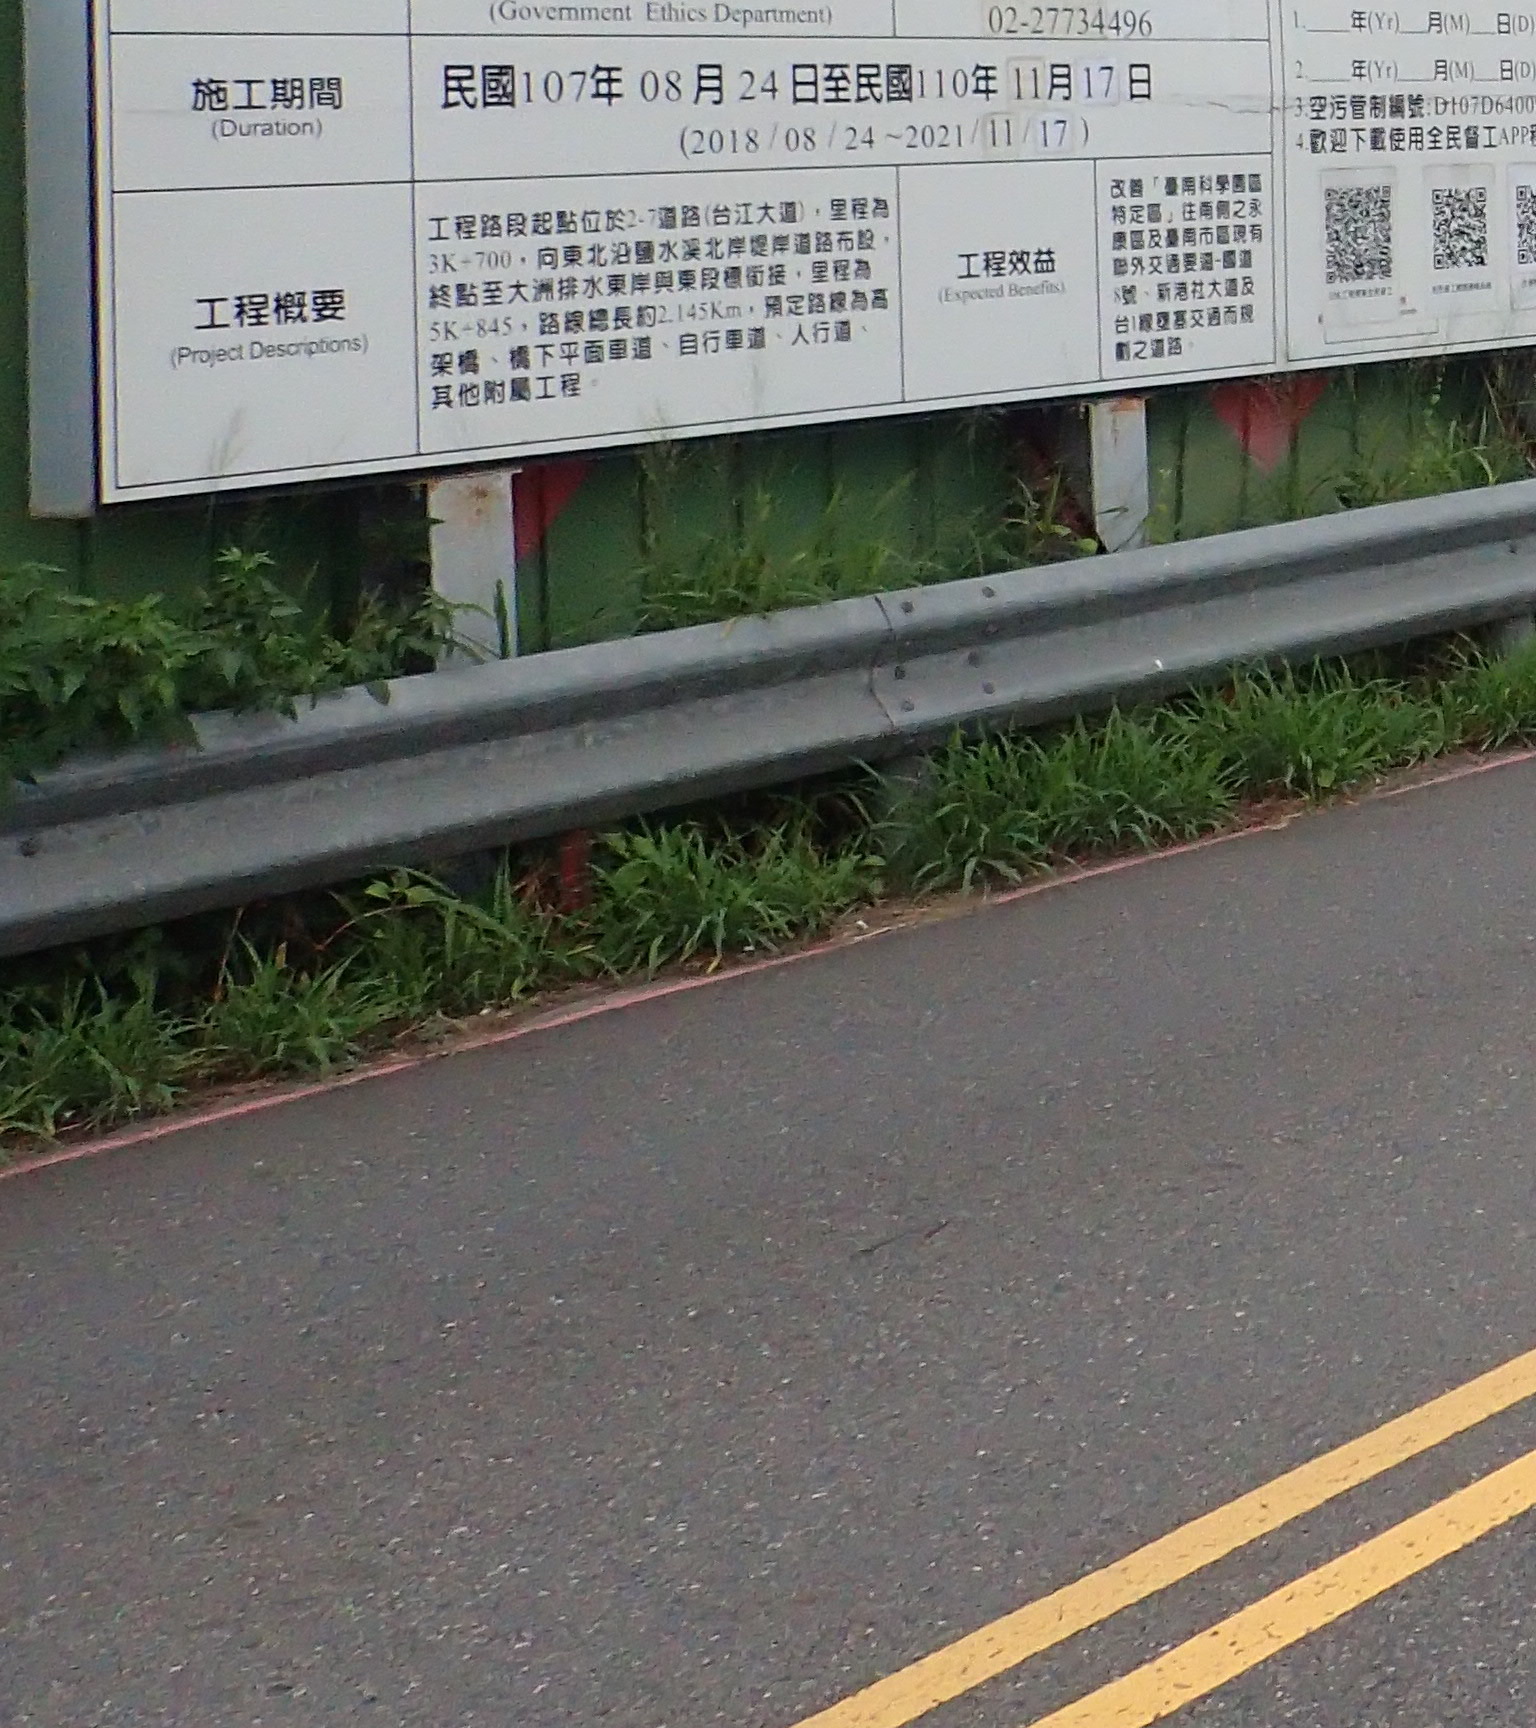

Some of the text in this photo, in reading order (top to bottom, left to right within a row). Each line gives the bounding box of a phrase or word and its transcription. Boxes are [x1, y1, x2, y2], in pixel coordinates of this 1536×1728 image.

[490, 0, 833, 27] (Government Ethics Department)
[988, 7, 1152, 37] 02-27734496
[191, 77, 343, 112] 施工期間
[212, 118, 322, 140] (Duration)
[957, 247, 1056, 279] 工程效益
[194, 289, 346, 332] 工程概要
[170, 335, 369, 369] (Project Descriptions)
